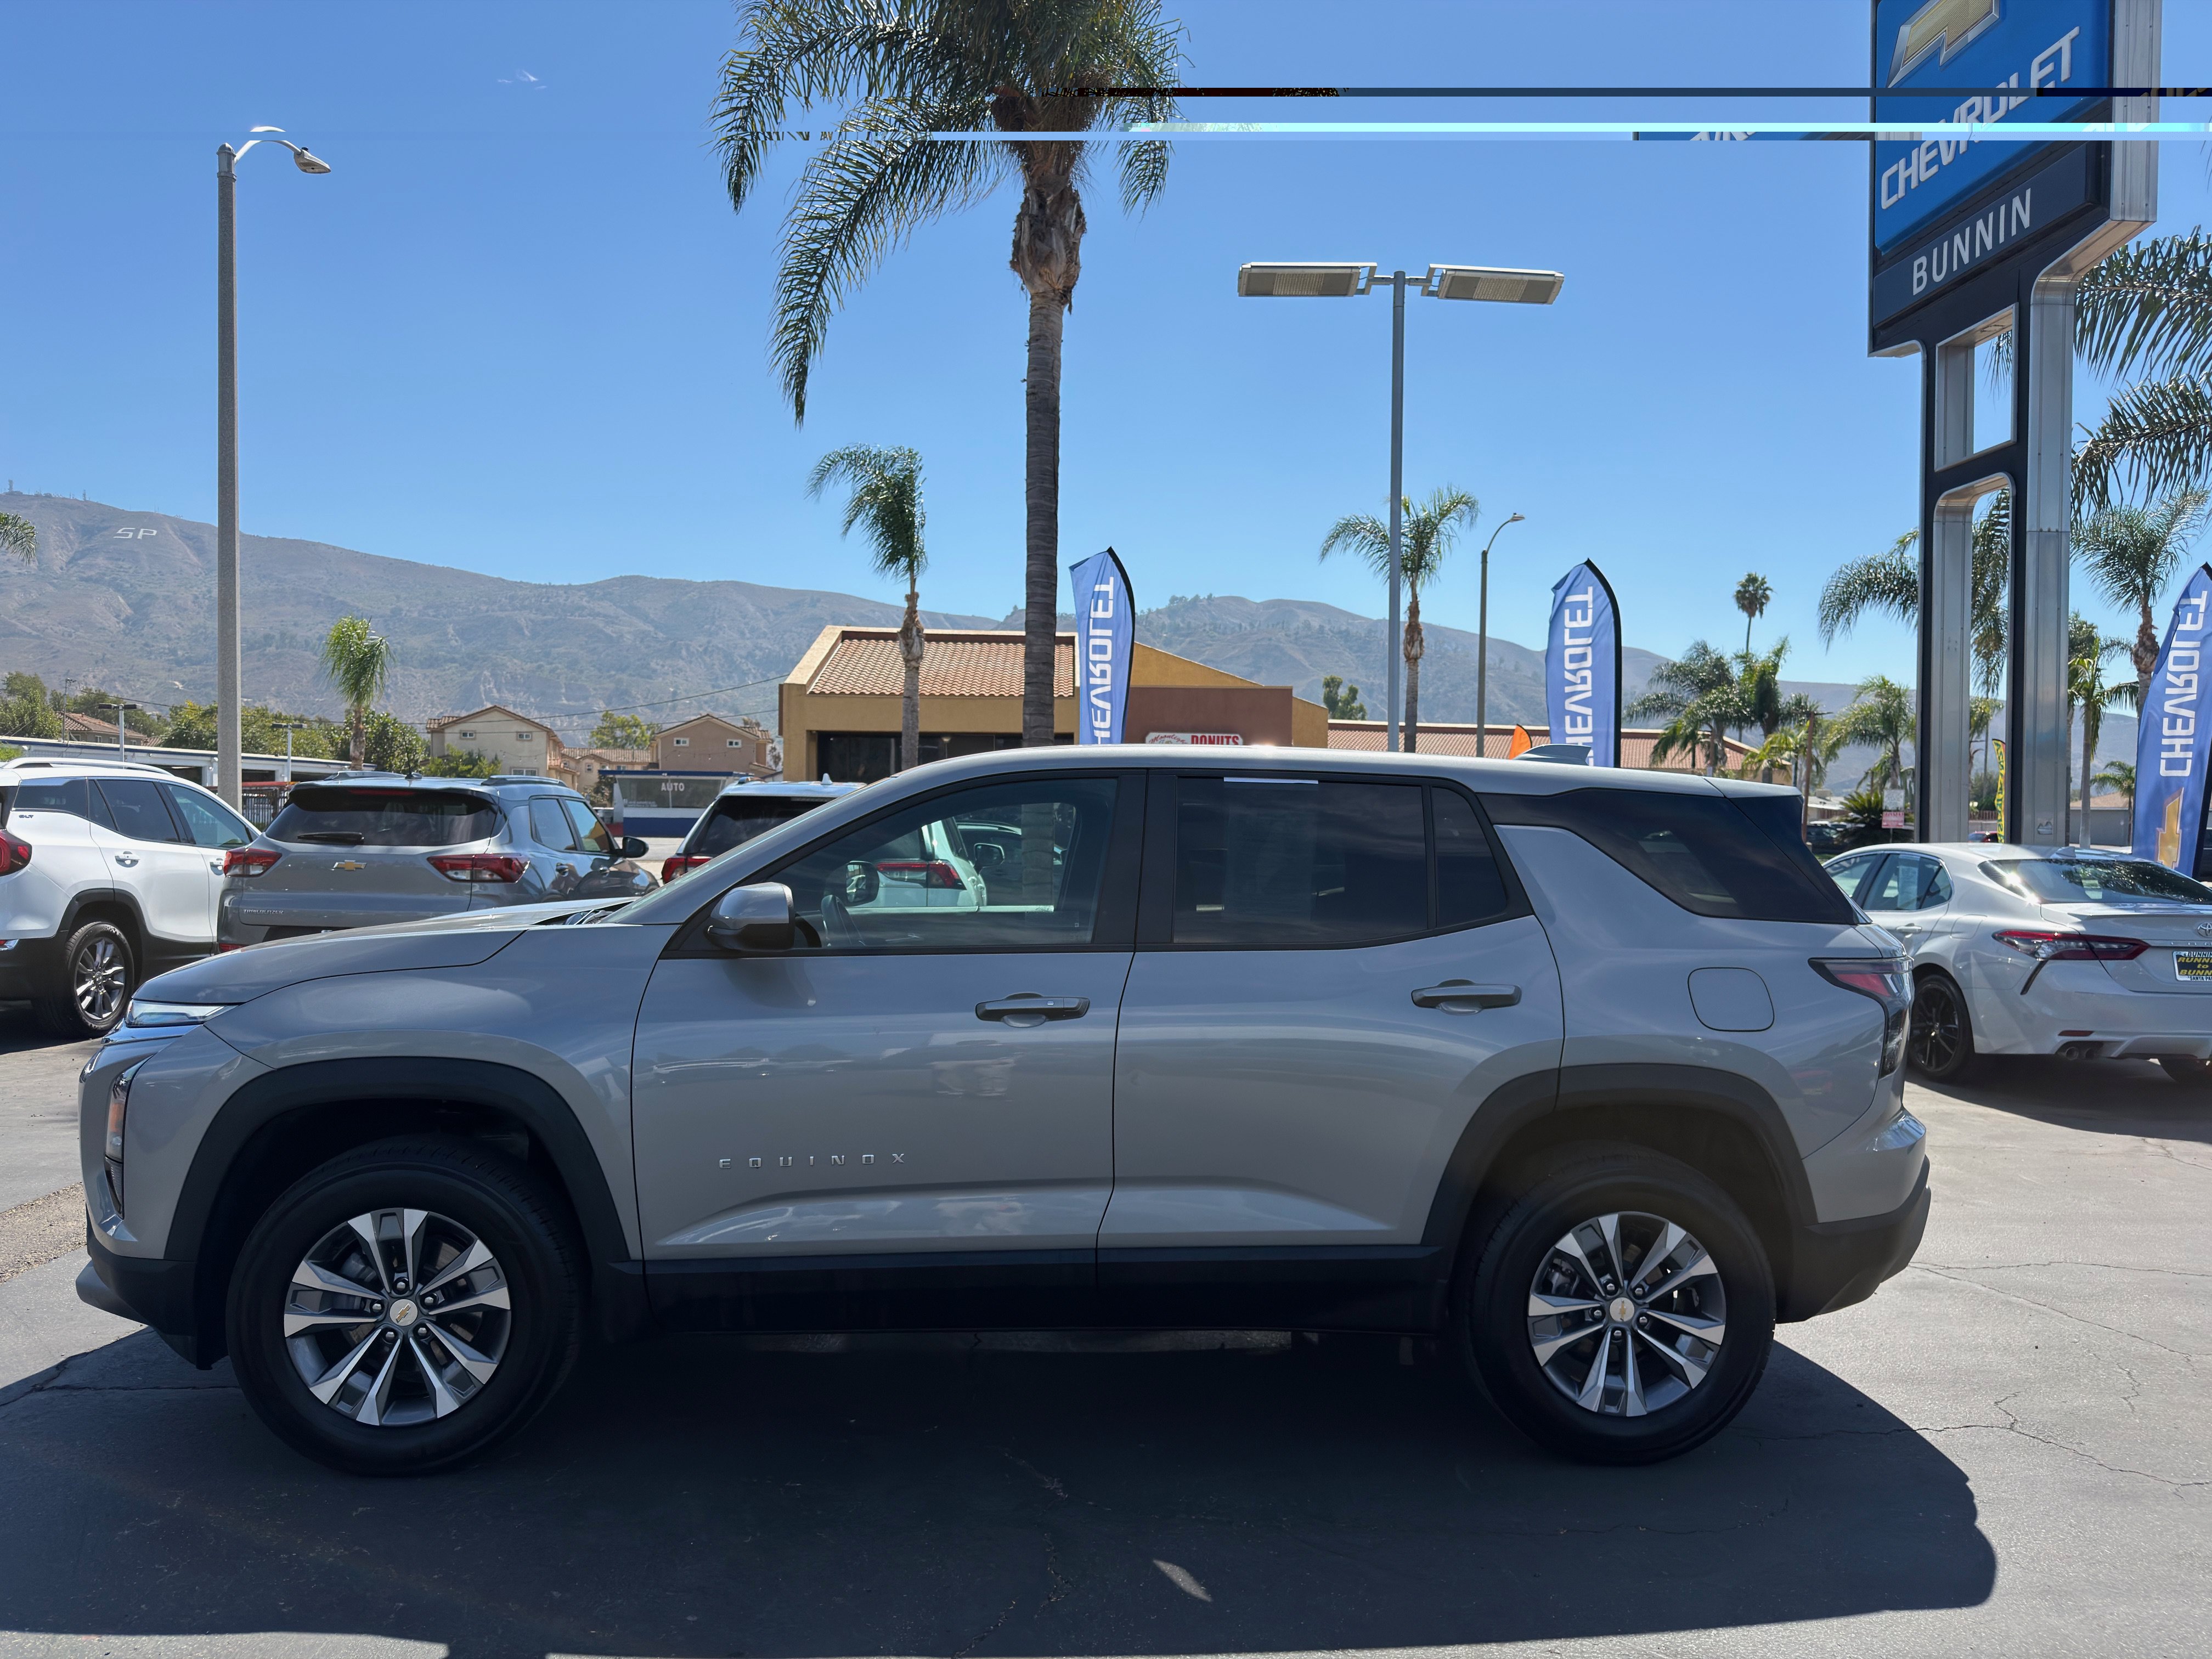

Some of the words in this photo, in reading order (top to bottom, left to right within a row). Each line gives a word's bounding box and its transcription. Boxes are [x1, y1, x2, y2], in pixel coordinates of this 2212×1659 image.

[1881, 26, 2081, 210] CHEVROLET
[1912, 188, 2032, 296] BUNNIN
[113, 528, 157, 539] SP
[1149, 734, 1188, 744] Moonligh
[1191, 735, 1239, 745] DONUTS
[661, 782, 685, 791] AUTO
[719, 1153, 905, 1169] EQUINOX
